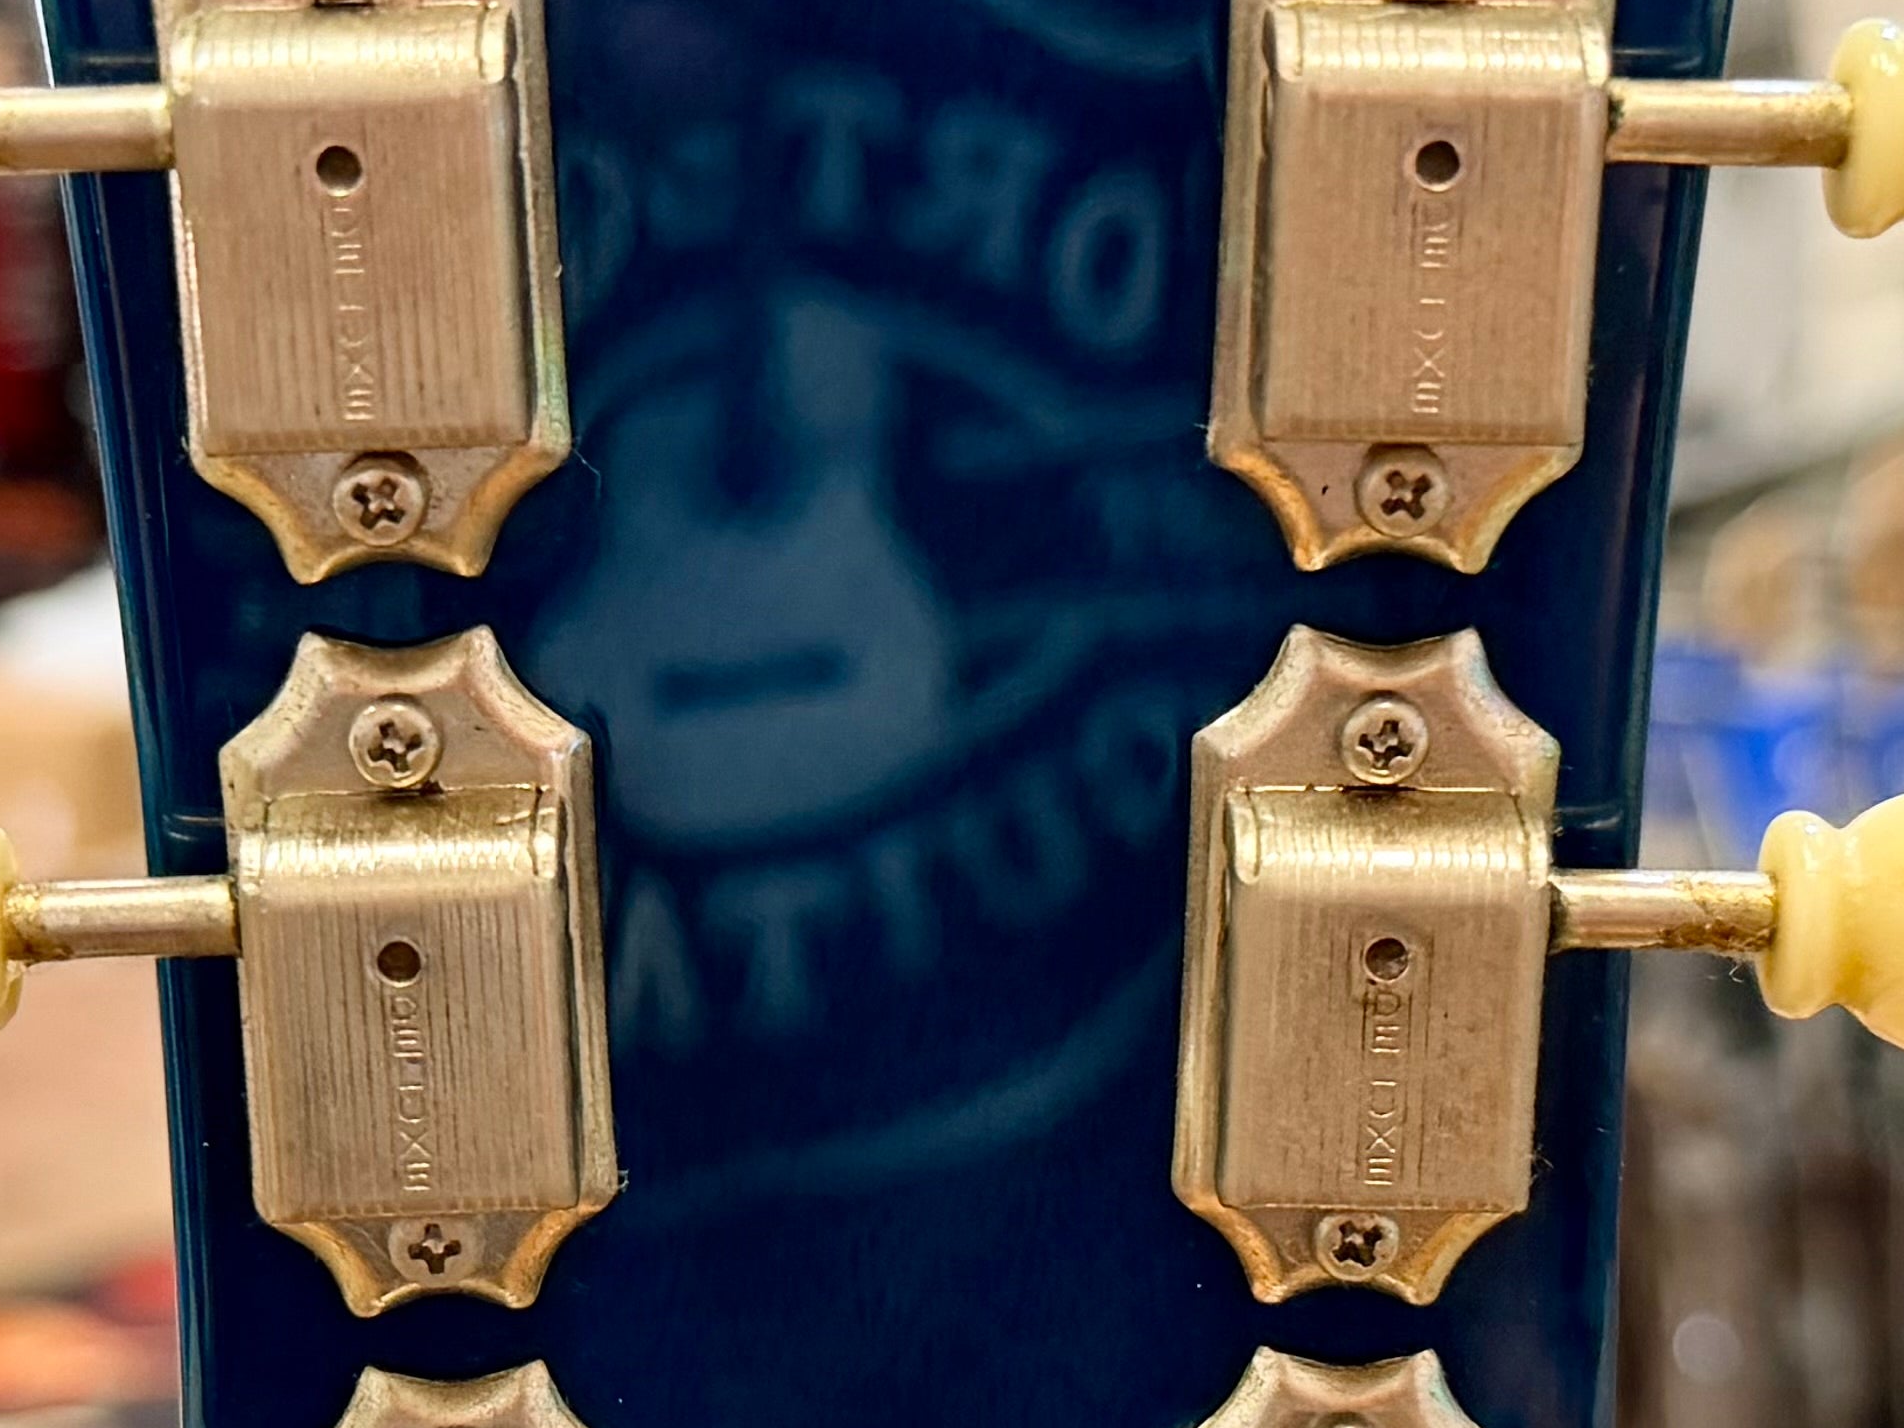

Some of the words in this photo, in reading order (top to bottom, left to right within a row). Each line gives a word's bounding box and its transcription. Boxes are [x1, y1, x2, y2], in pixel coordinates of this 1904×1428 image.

[330, 205, 376, 421] DELUXE
[1410, 200, 1454, 414] DELUXE
[390, 996, 433, 1192] DELUXE
[1362, 992, 1402, 1186] DELUXE
